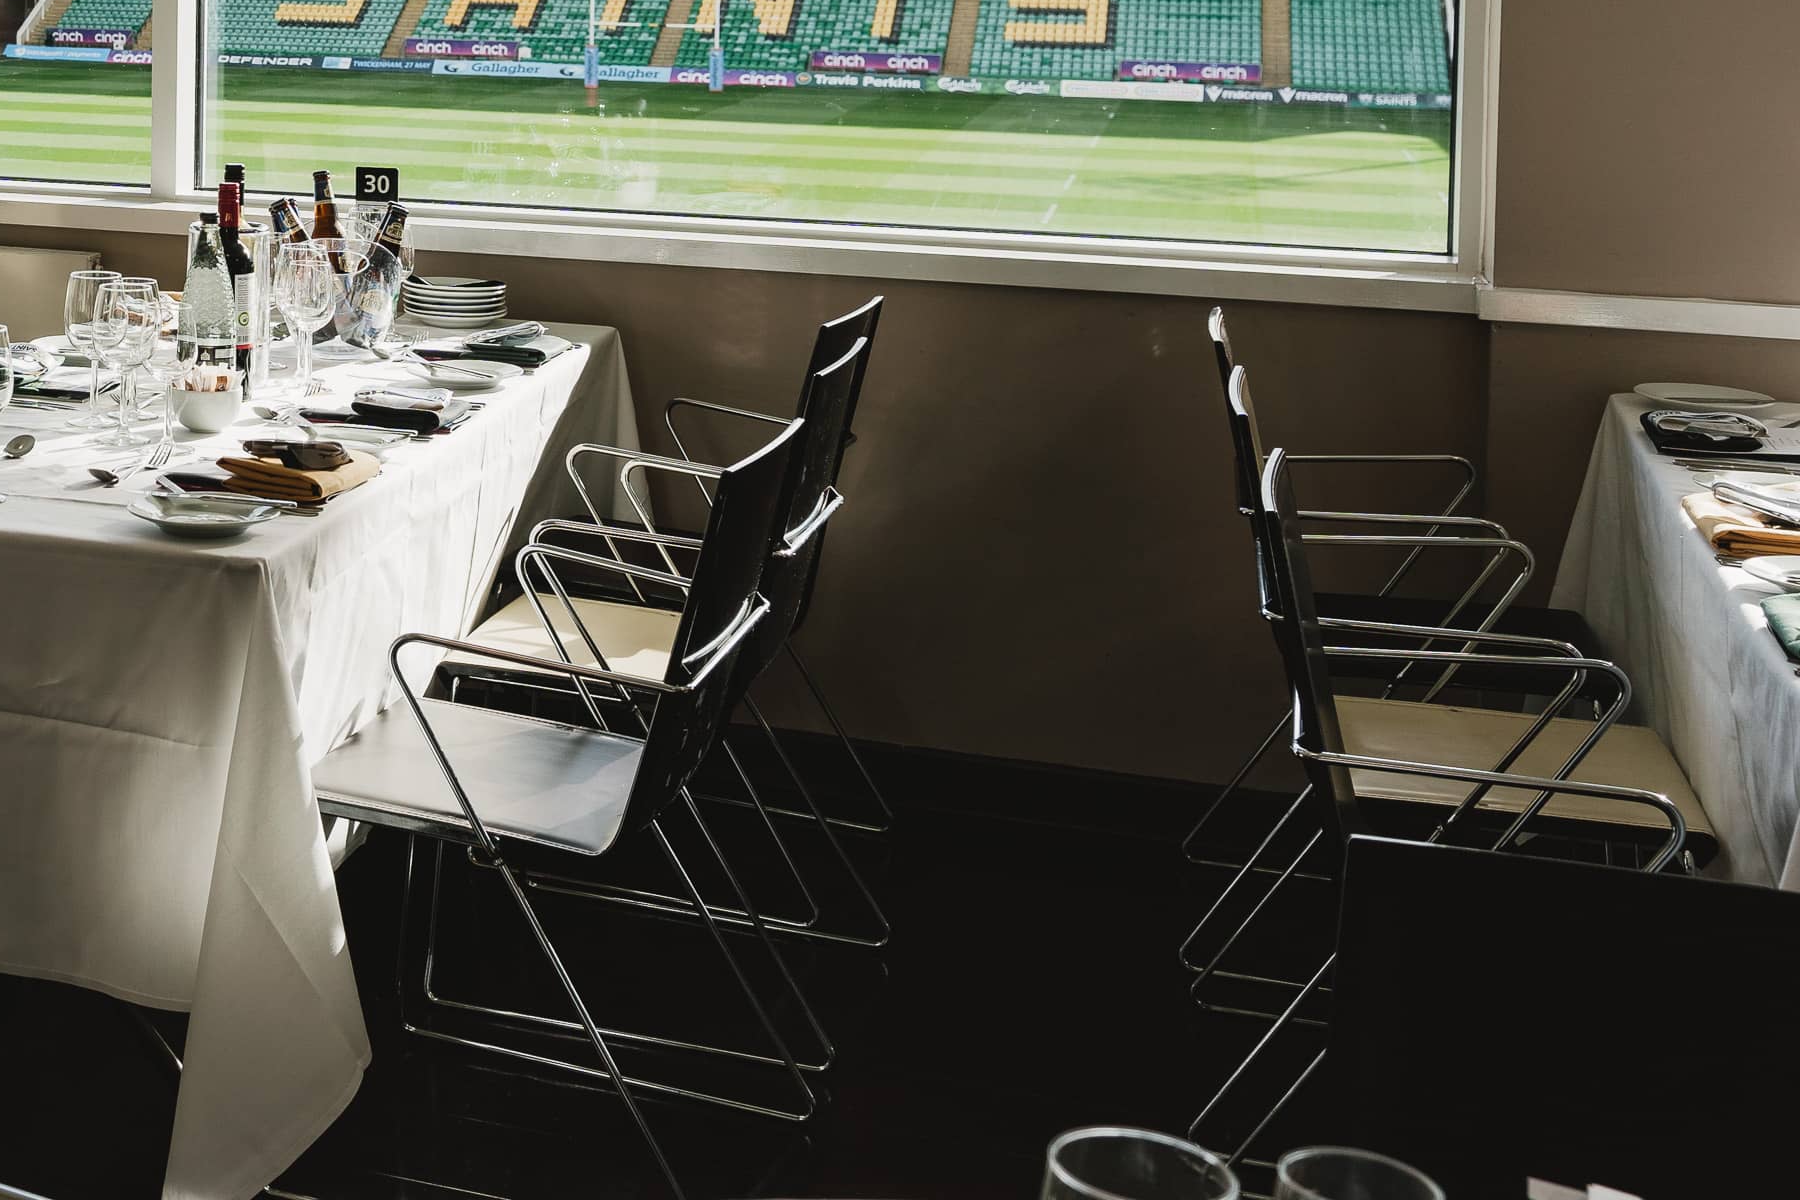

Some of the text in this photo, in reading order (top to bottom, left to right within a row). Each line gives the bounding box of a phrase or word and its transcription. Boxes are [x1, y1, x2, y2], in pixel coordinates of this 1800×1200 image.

[416, 40, 451, 54] cinch
[472, 41, 508, 56] cinch
[218, 55, 313, 66] DEFENDER
[824, 54, 864, 68] cinch
[888, 56, 928, 69] cinch
[472, 63, 540, 75] Gallagher
[598, 68, 660, 80] allagher
[1132, 63, 1177, 77] cinch
[1202, 65, 1247, 80] cinch
[678, 71, 710, 84] cinc
[740, 72, 787, 86] cinch
[814, 74, 920, 89] Travis Perkins
[1221, 90, 1273, 101] macron
[1296, 92, 1348, 103] macron
[1375, 94, 1417, 106] SAINTS
[363, 174, 390, 194] 30
